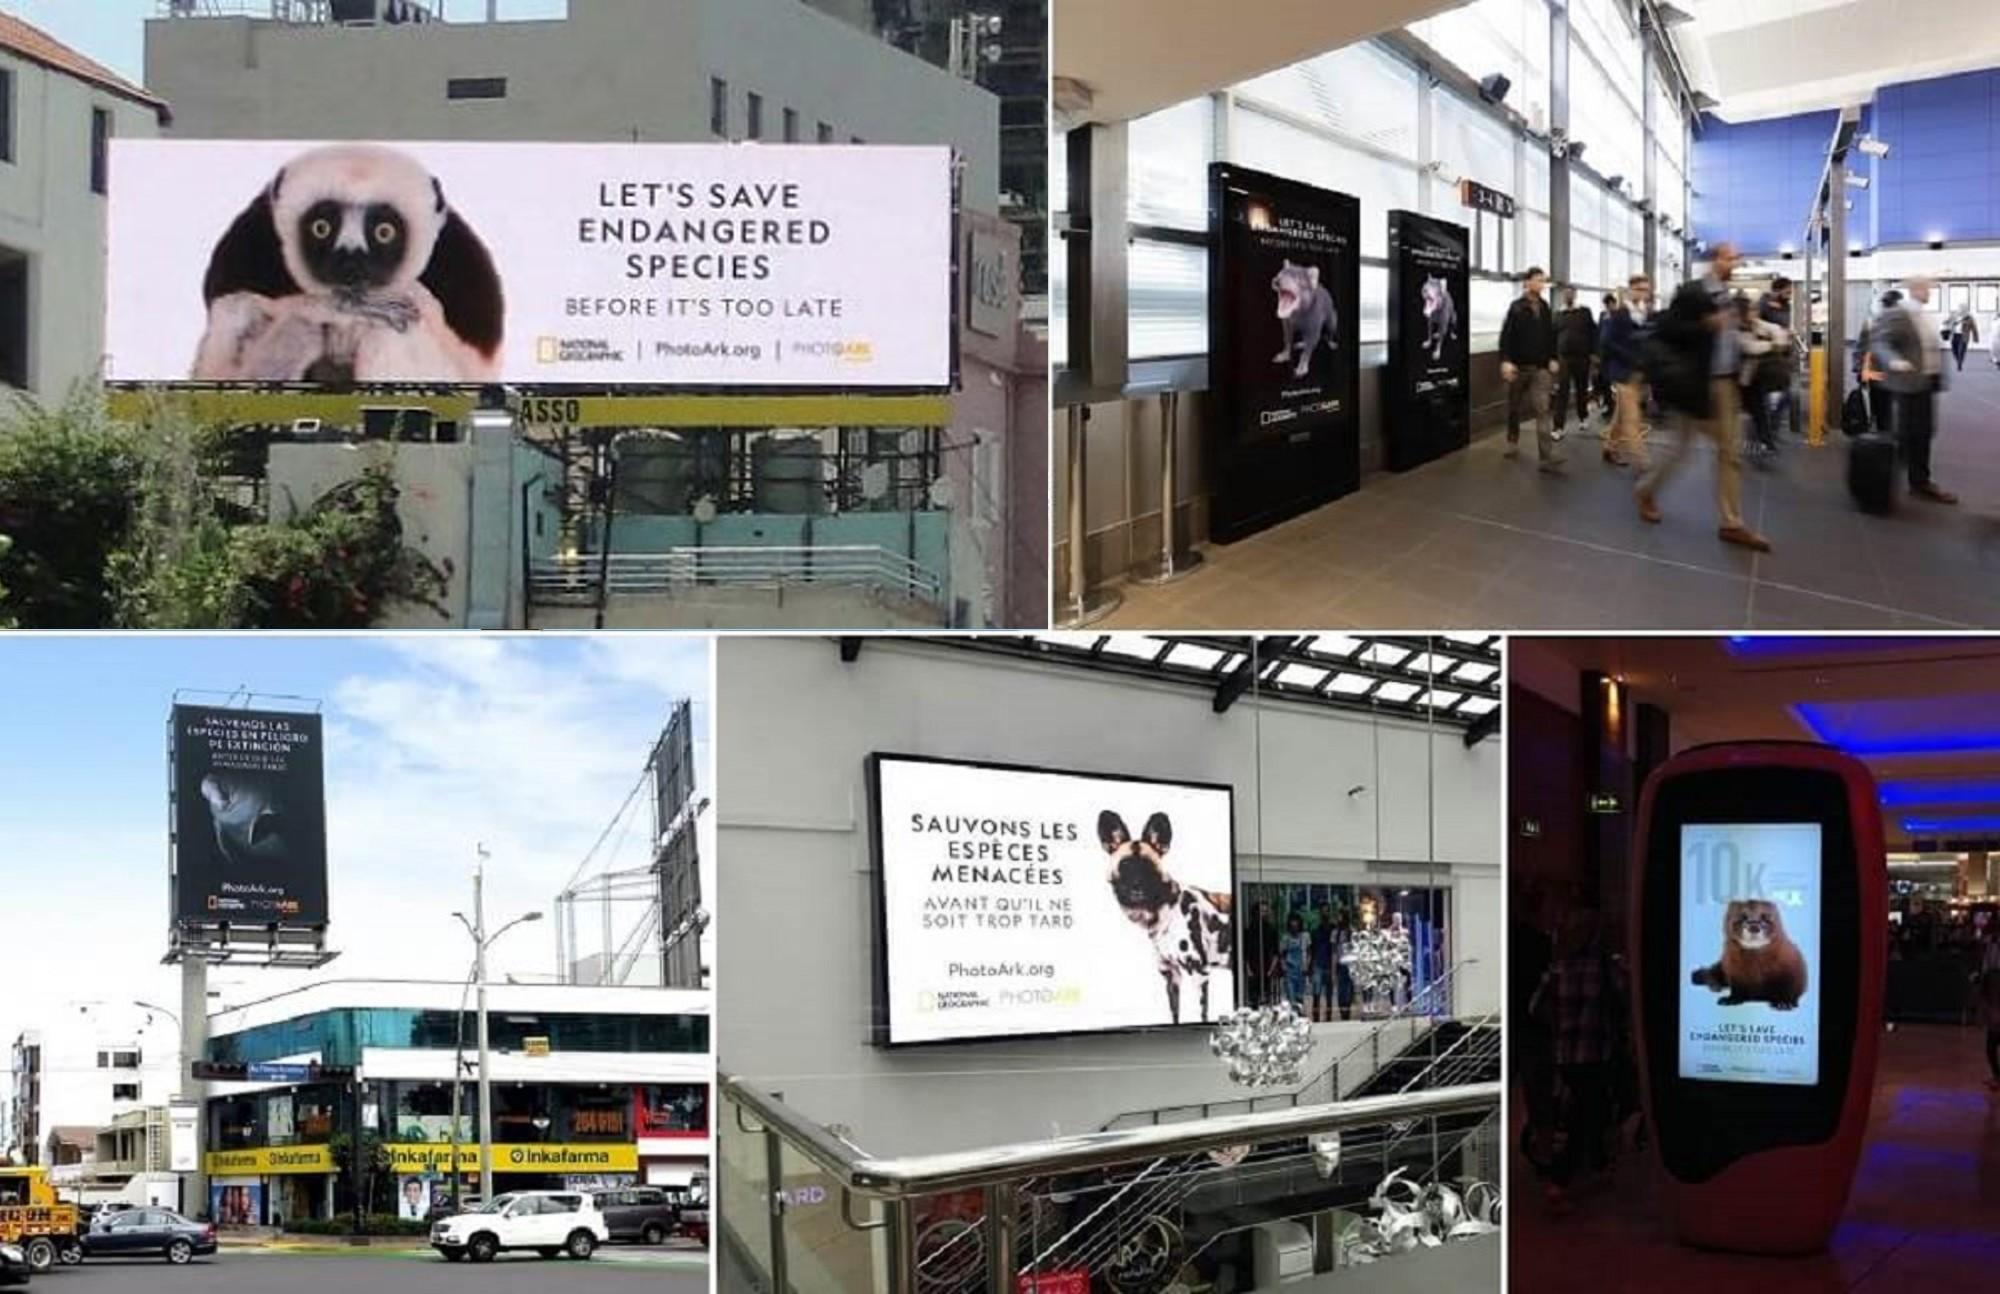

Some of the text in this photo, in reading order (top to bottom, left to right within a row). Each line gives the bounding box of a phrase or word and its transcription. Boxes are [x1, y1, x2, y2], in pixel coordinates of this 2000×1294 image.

[600, 183, 800, 209] LET'S SAVE
[579, 218, 831, 245] ENDANGERED
[627, 254, 771, 280] SPECIES
[565, 297, 843, 318] BEFORE IT'S TOO LATE
[656, 341, 762, 360] PhotoArk.org
[911, 813, 1078, 841] SAUVONS LES
[949, 838, 1049, 862] ESPÈCES
[932, 863, 1063, 885] MENACÉES
[924, 896, 1072, 911] AVANT QU'IL NE
[923, 914, 1073, 929] SOIT TROP TARD
[949, 963, 1055, 978] PhotoArk.org
[527, 1149, 610, 1163] Inkafarma
